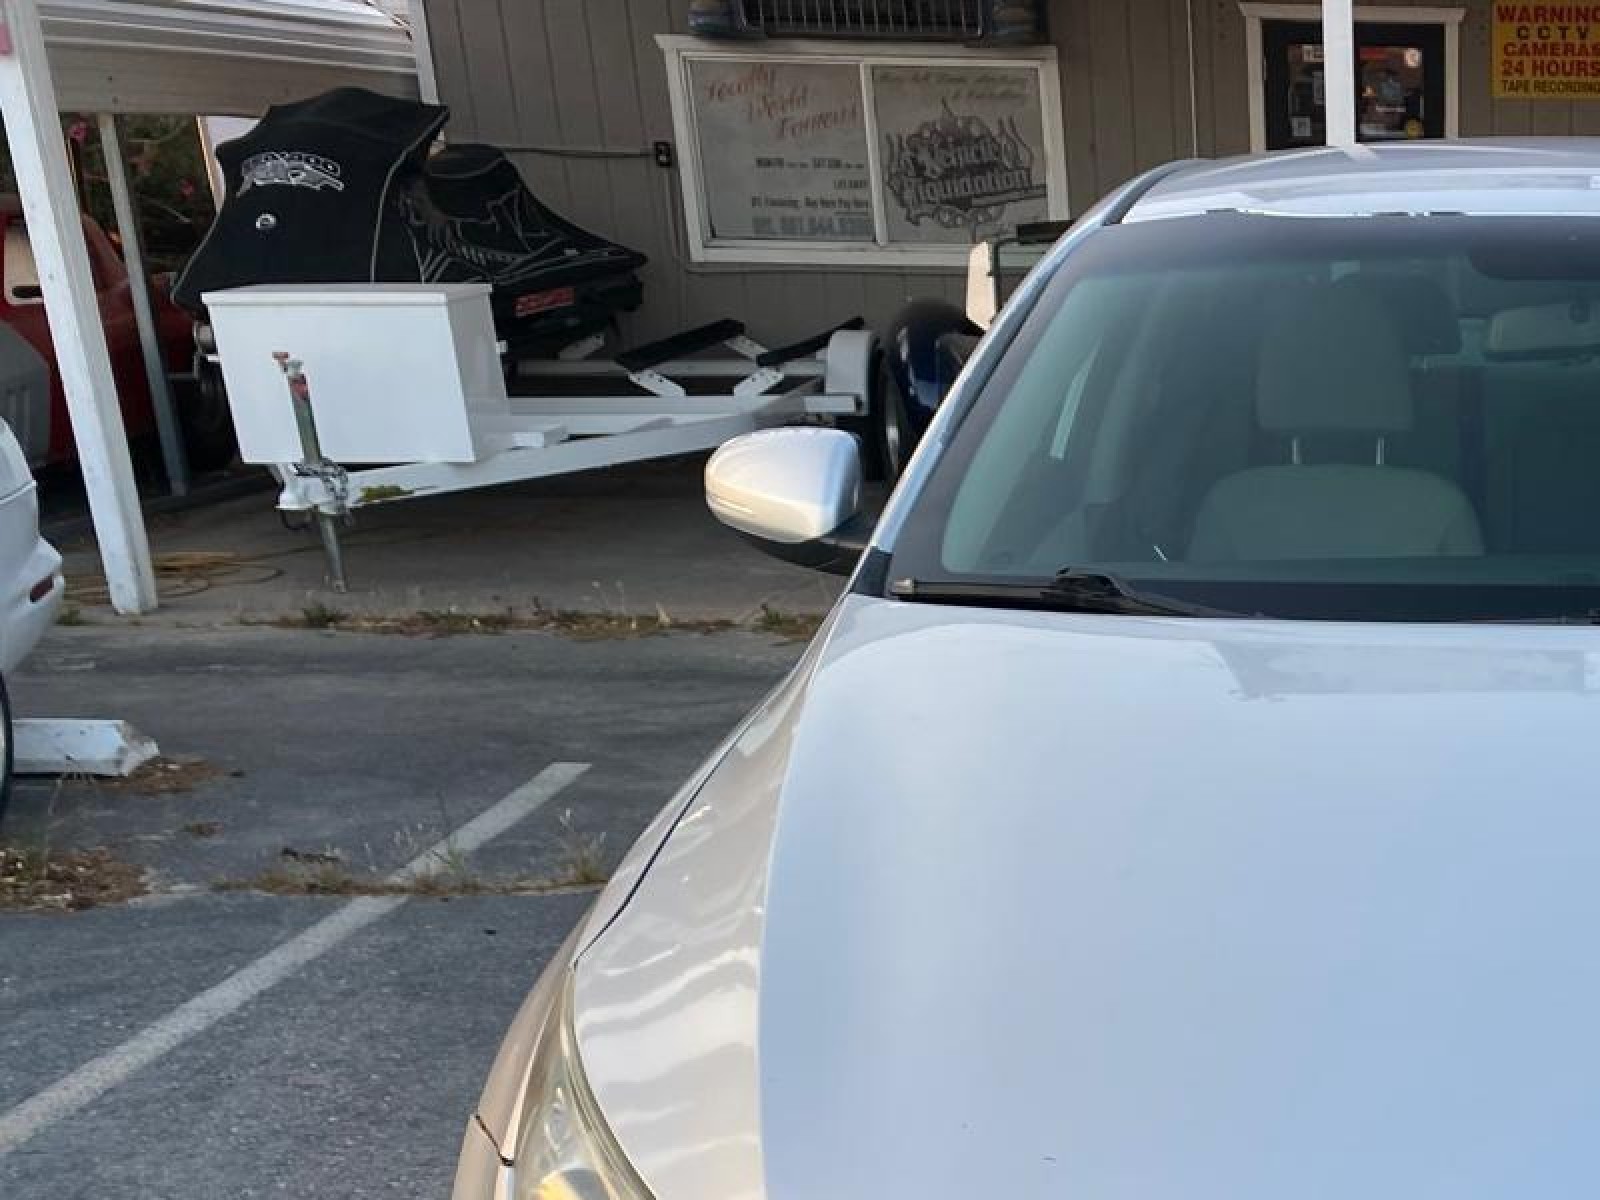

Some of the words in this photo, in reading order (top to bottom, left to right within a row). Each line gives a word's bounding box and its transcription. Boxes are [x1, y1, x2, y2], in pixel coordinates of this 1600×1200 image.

[1517, 25, 1590, 40] CCTV
[1502, 60, 1525, 76] 24
[1531, 60, 1600, 76] HOURS
[1503, 79, 1529, 93] TAPE
[1534, 81, 1600, 94] RECORDING
